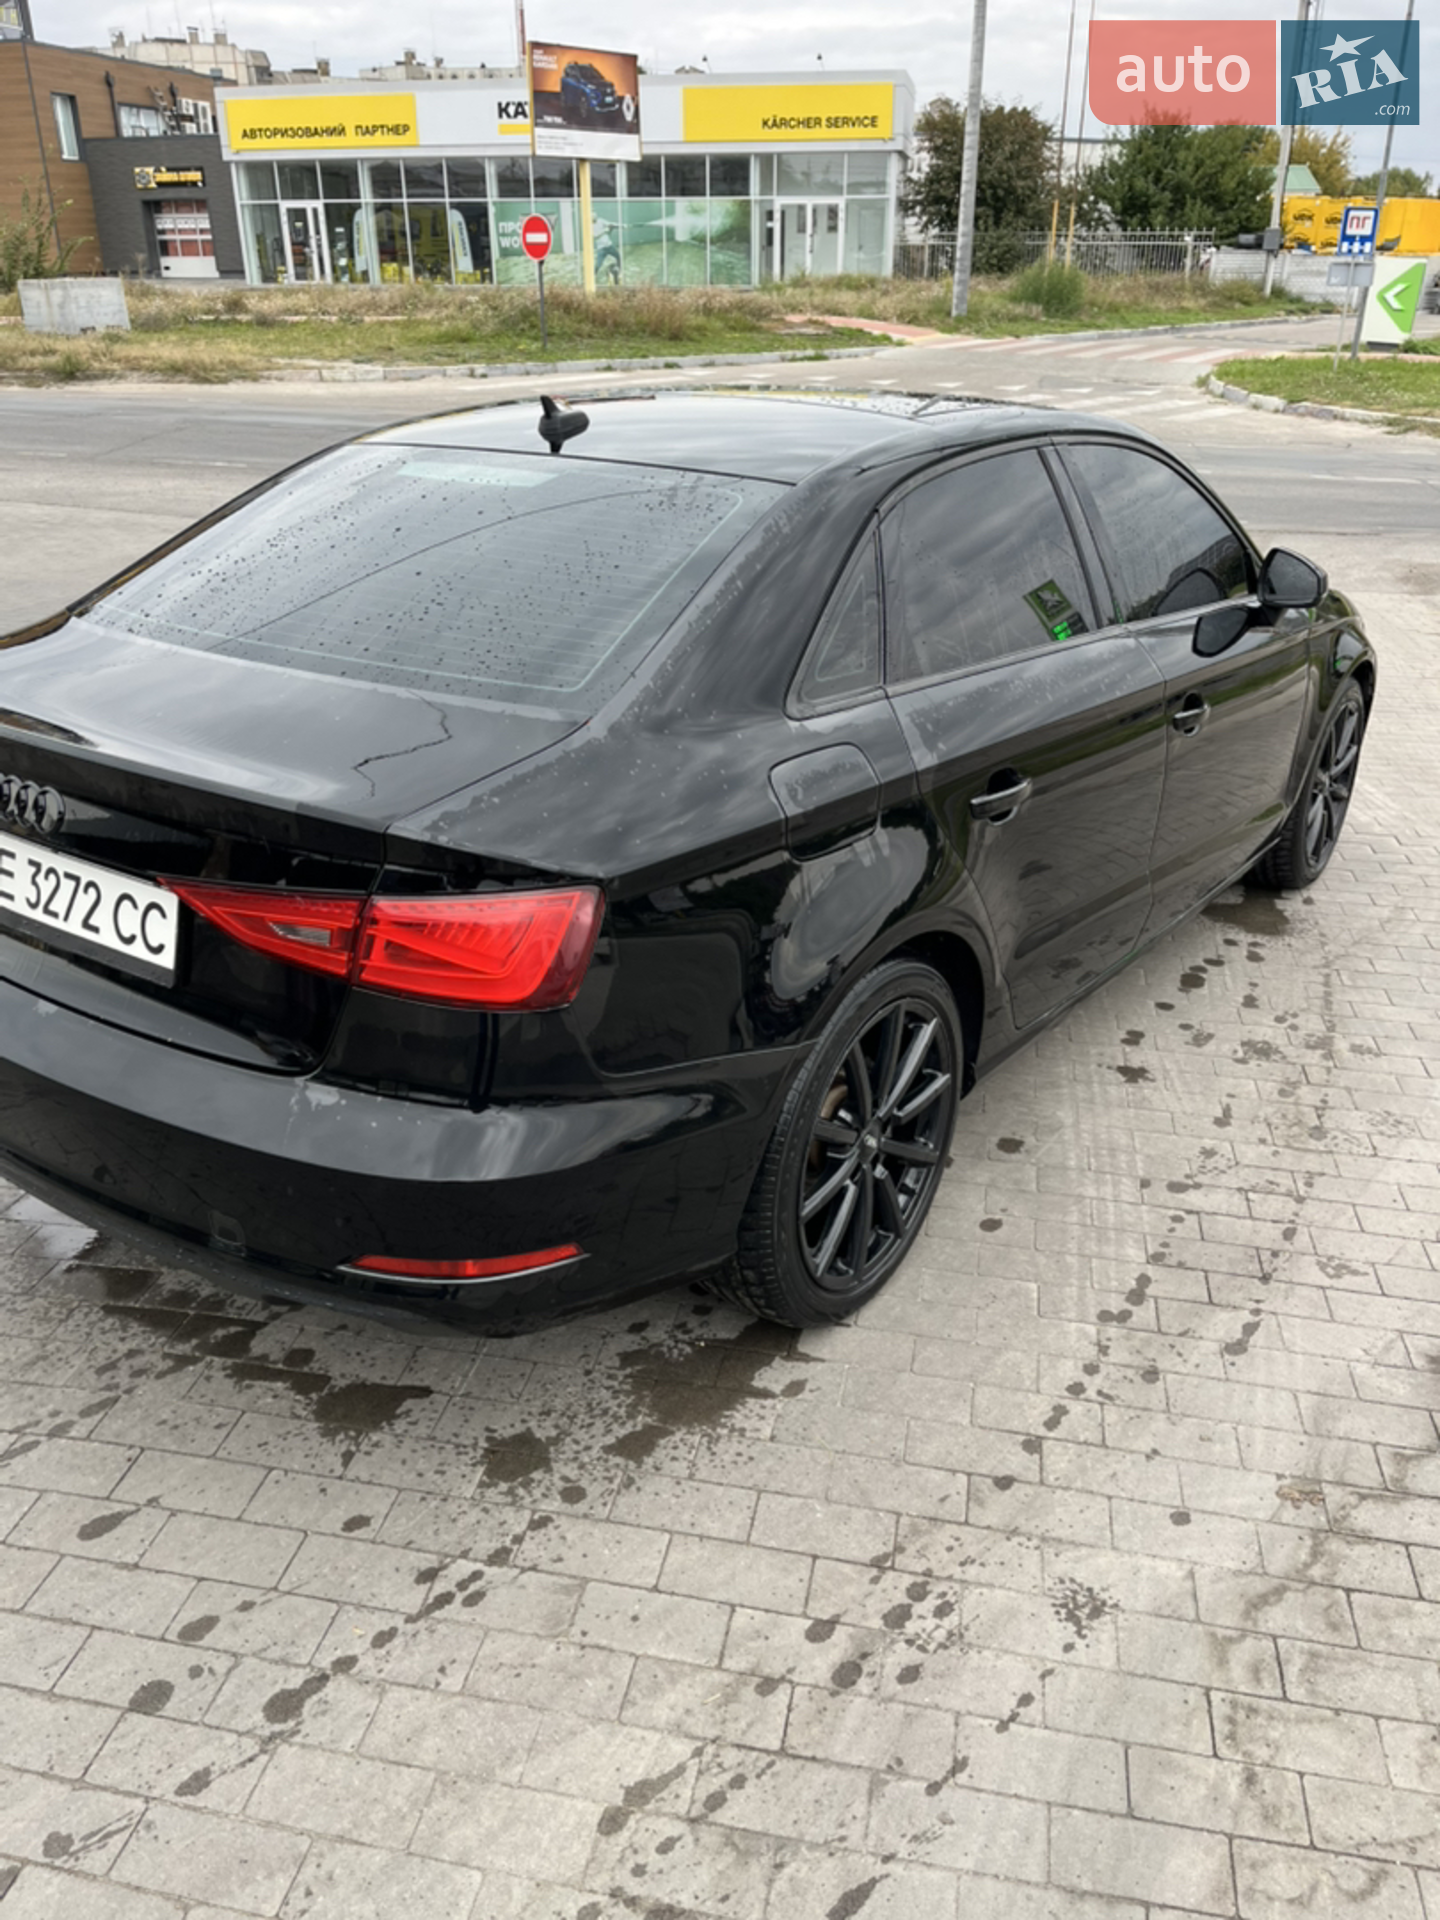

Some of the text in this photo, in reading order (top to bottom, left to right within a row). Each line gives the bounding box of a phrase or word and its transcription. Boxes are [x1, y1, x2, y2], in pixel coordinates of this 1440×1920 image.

[761, 115, 879, 129] KÄRCHER SERVICE
[241, 123, 411, 140] АВТОРИЗОВАНИЙ ПАРТНЕР
[25, 858, 102, 935] 3272
[113, 892, 167, 956] CC
